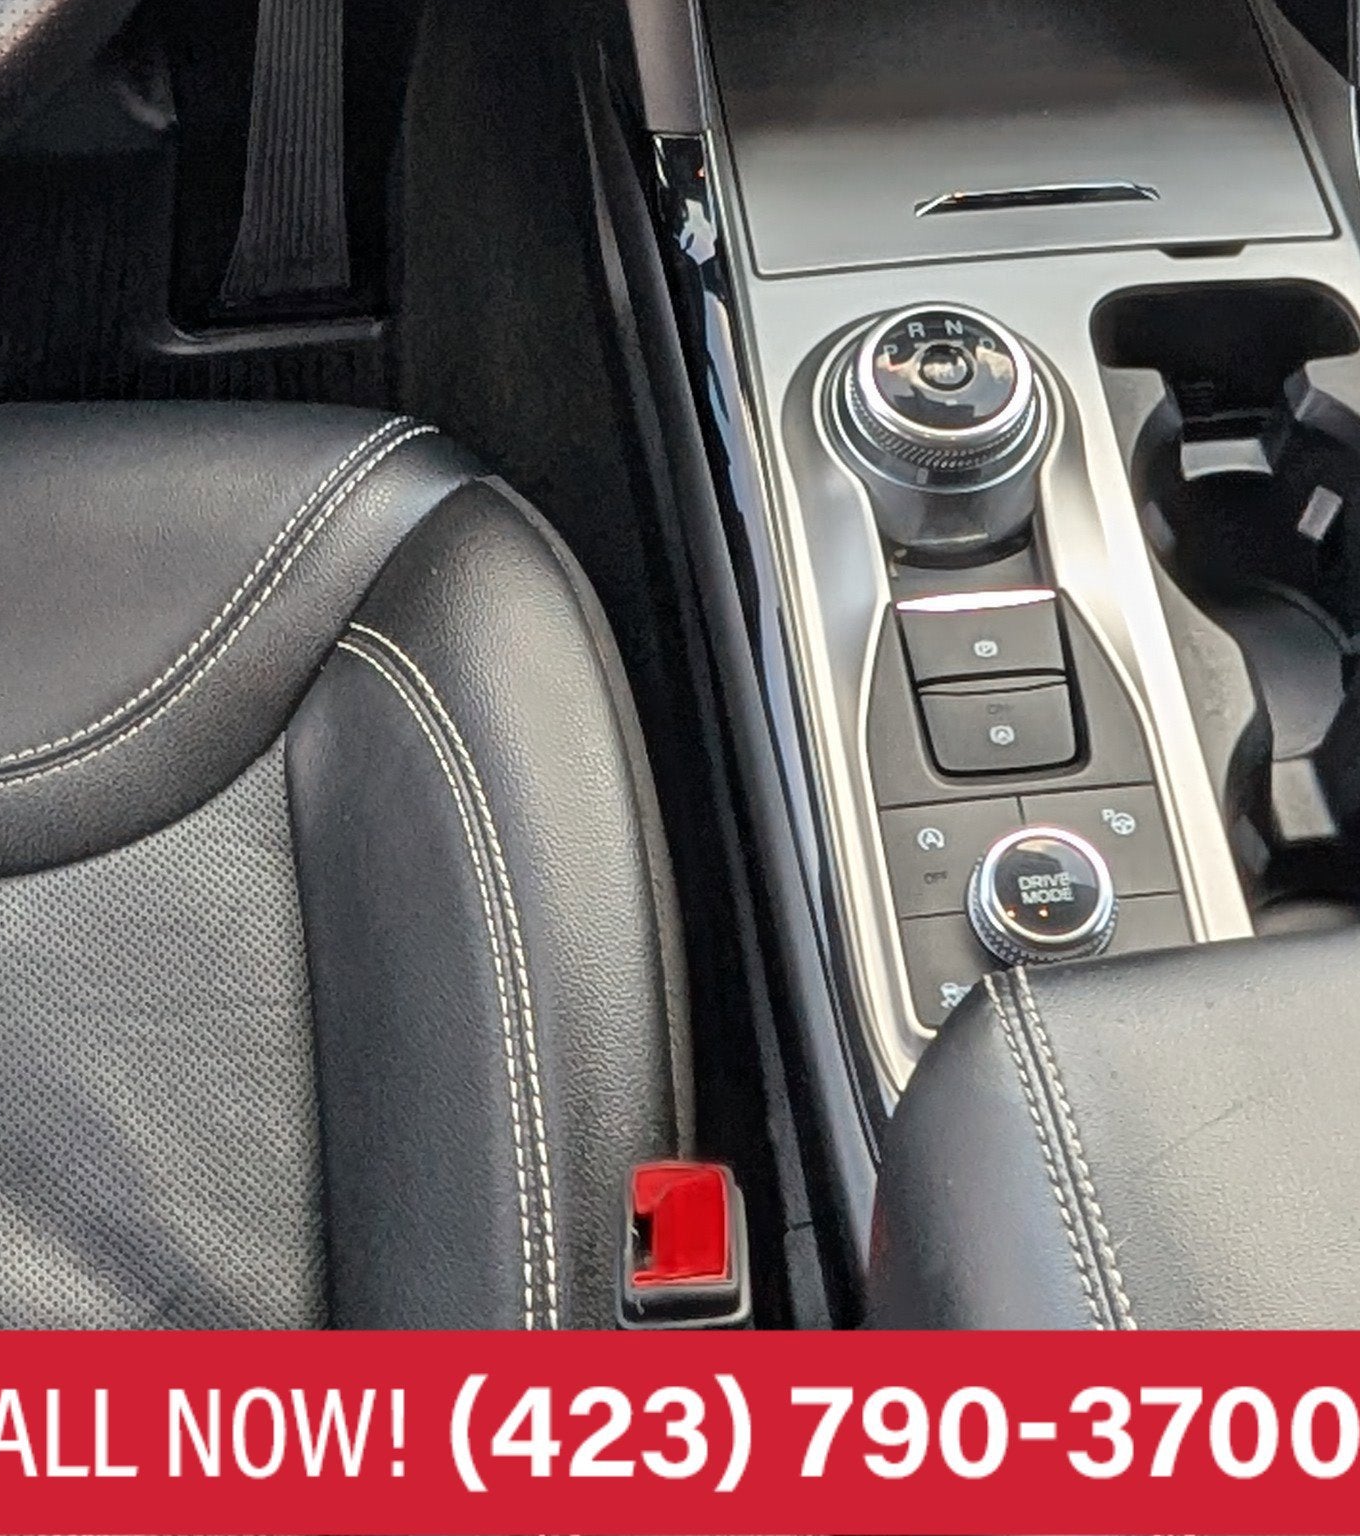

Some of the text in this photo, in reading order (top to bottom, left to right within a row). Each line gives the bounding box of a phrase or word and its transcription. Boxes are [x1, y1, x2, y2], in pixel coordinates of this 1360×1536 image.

[907, 321, 926, 339] R
[944, 319, 964, 336] N
[1018, 872, 1070, 891] DRIVE
[1021, 888, 1075, 906] MODE
